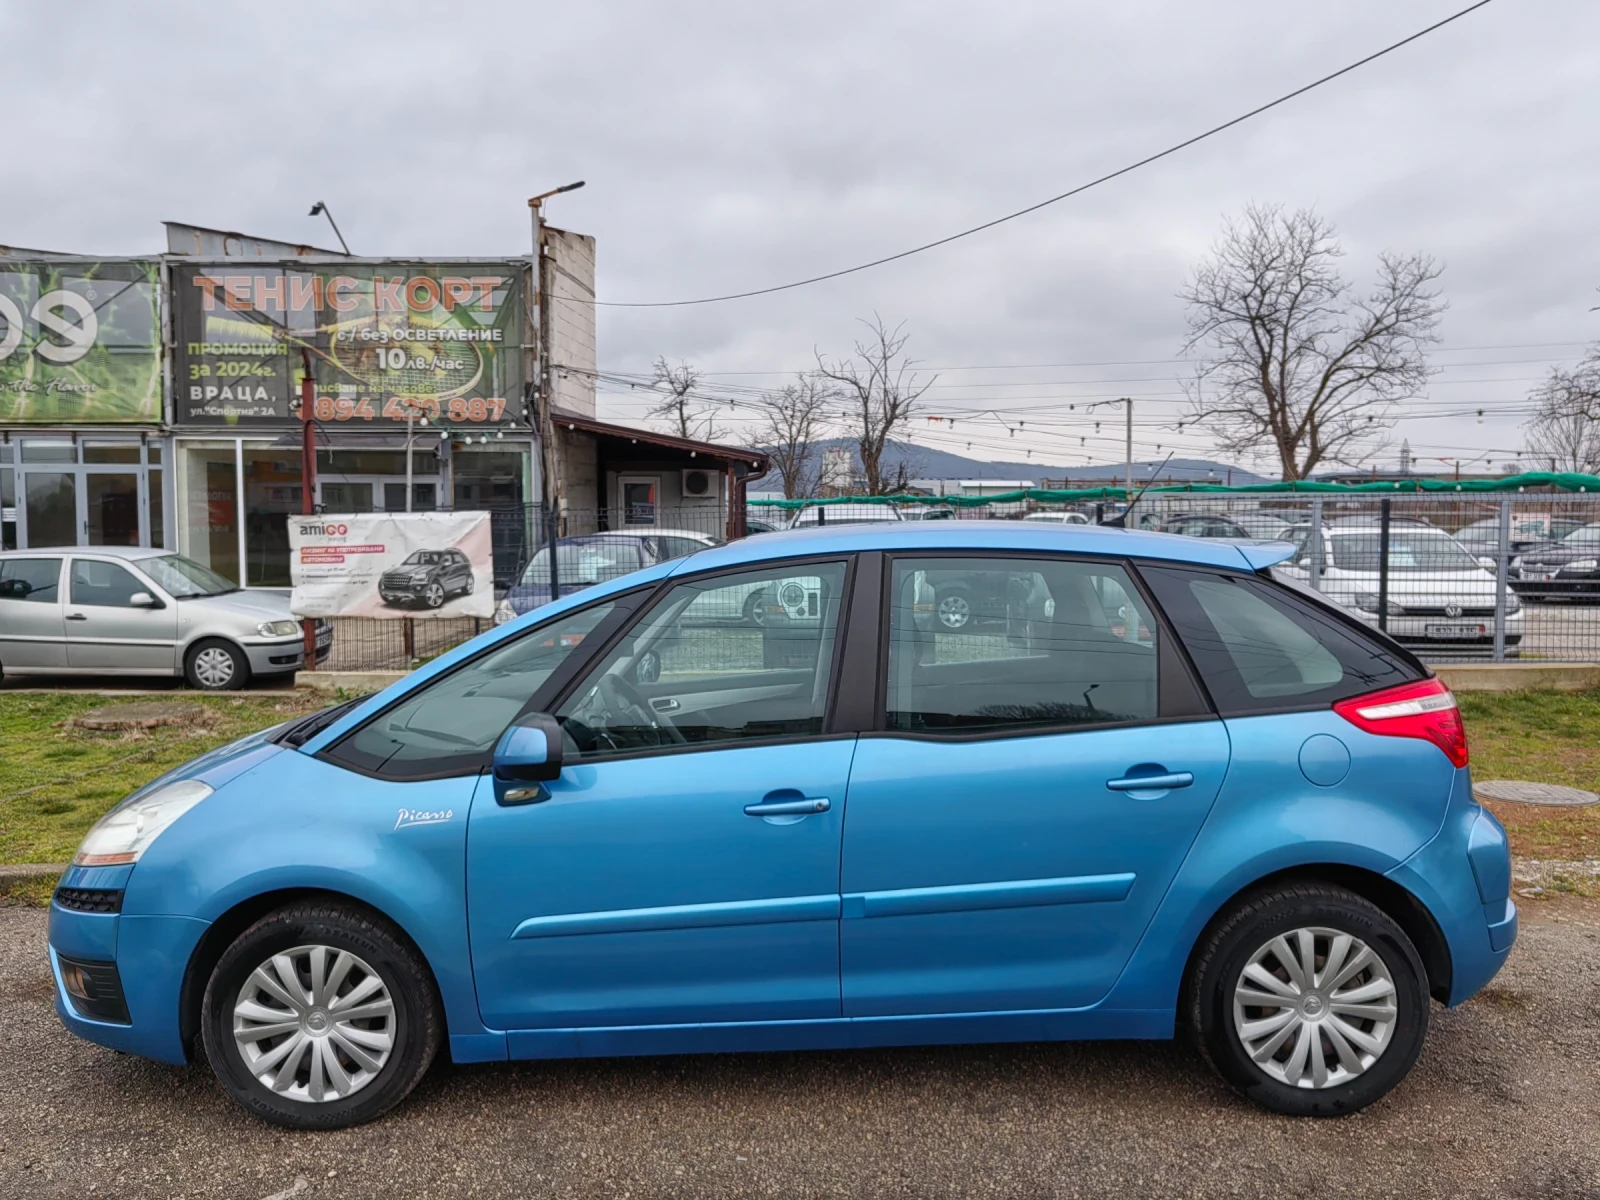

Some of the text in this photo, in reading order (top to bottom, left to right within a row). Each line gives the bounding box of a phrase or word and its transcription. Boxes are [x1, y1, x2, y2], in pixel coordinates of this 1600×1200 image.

[193, 276, 502, 312] ТЕНИС КОРТ
[361, 328, 389, 343] без
[392, 329, 503, 342] ОСВЕТЛЕНИЕ
[187, 343, 288, 357] ПРОМОЦИЯ
[189, 363, 211, 380] за
[190, 386, 276, 402] ВРАЦА,
[297, 398, 506, 422] 894 420 887
[394, 808, 453, 830] Picasso
